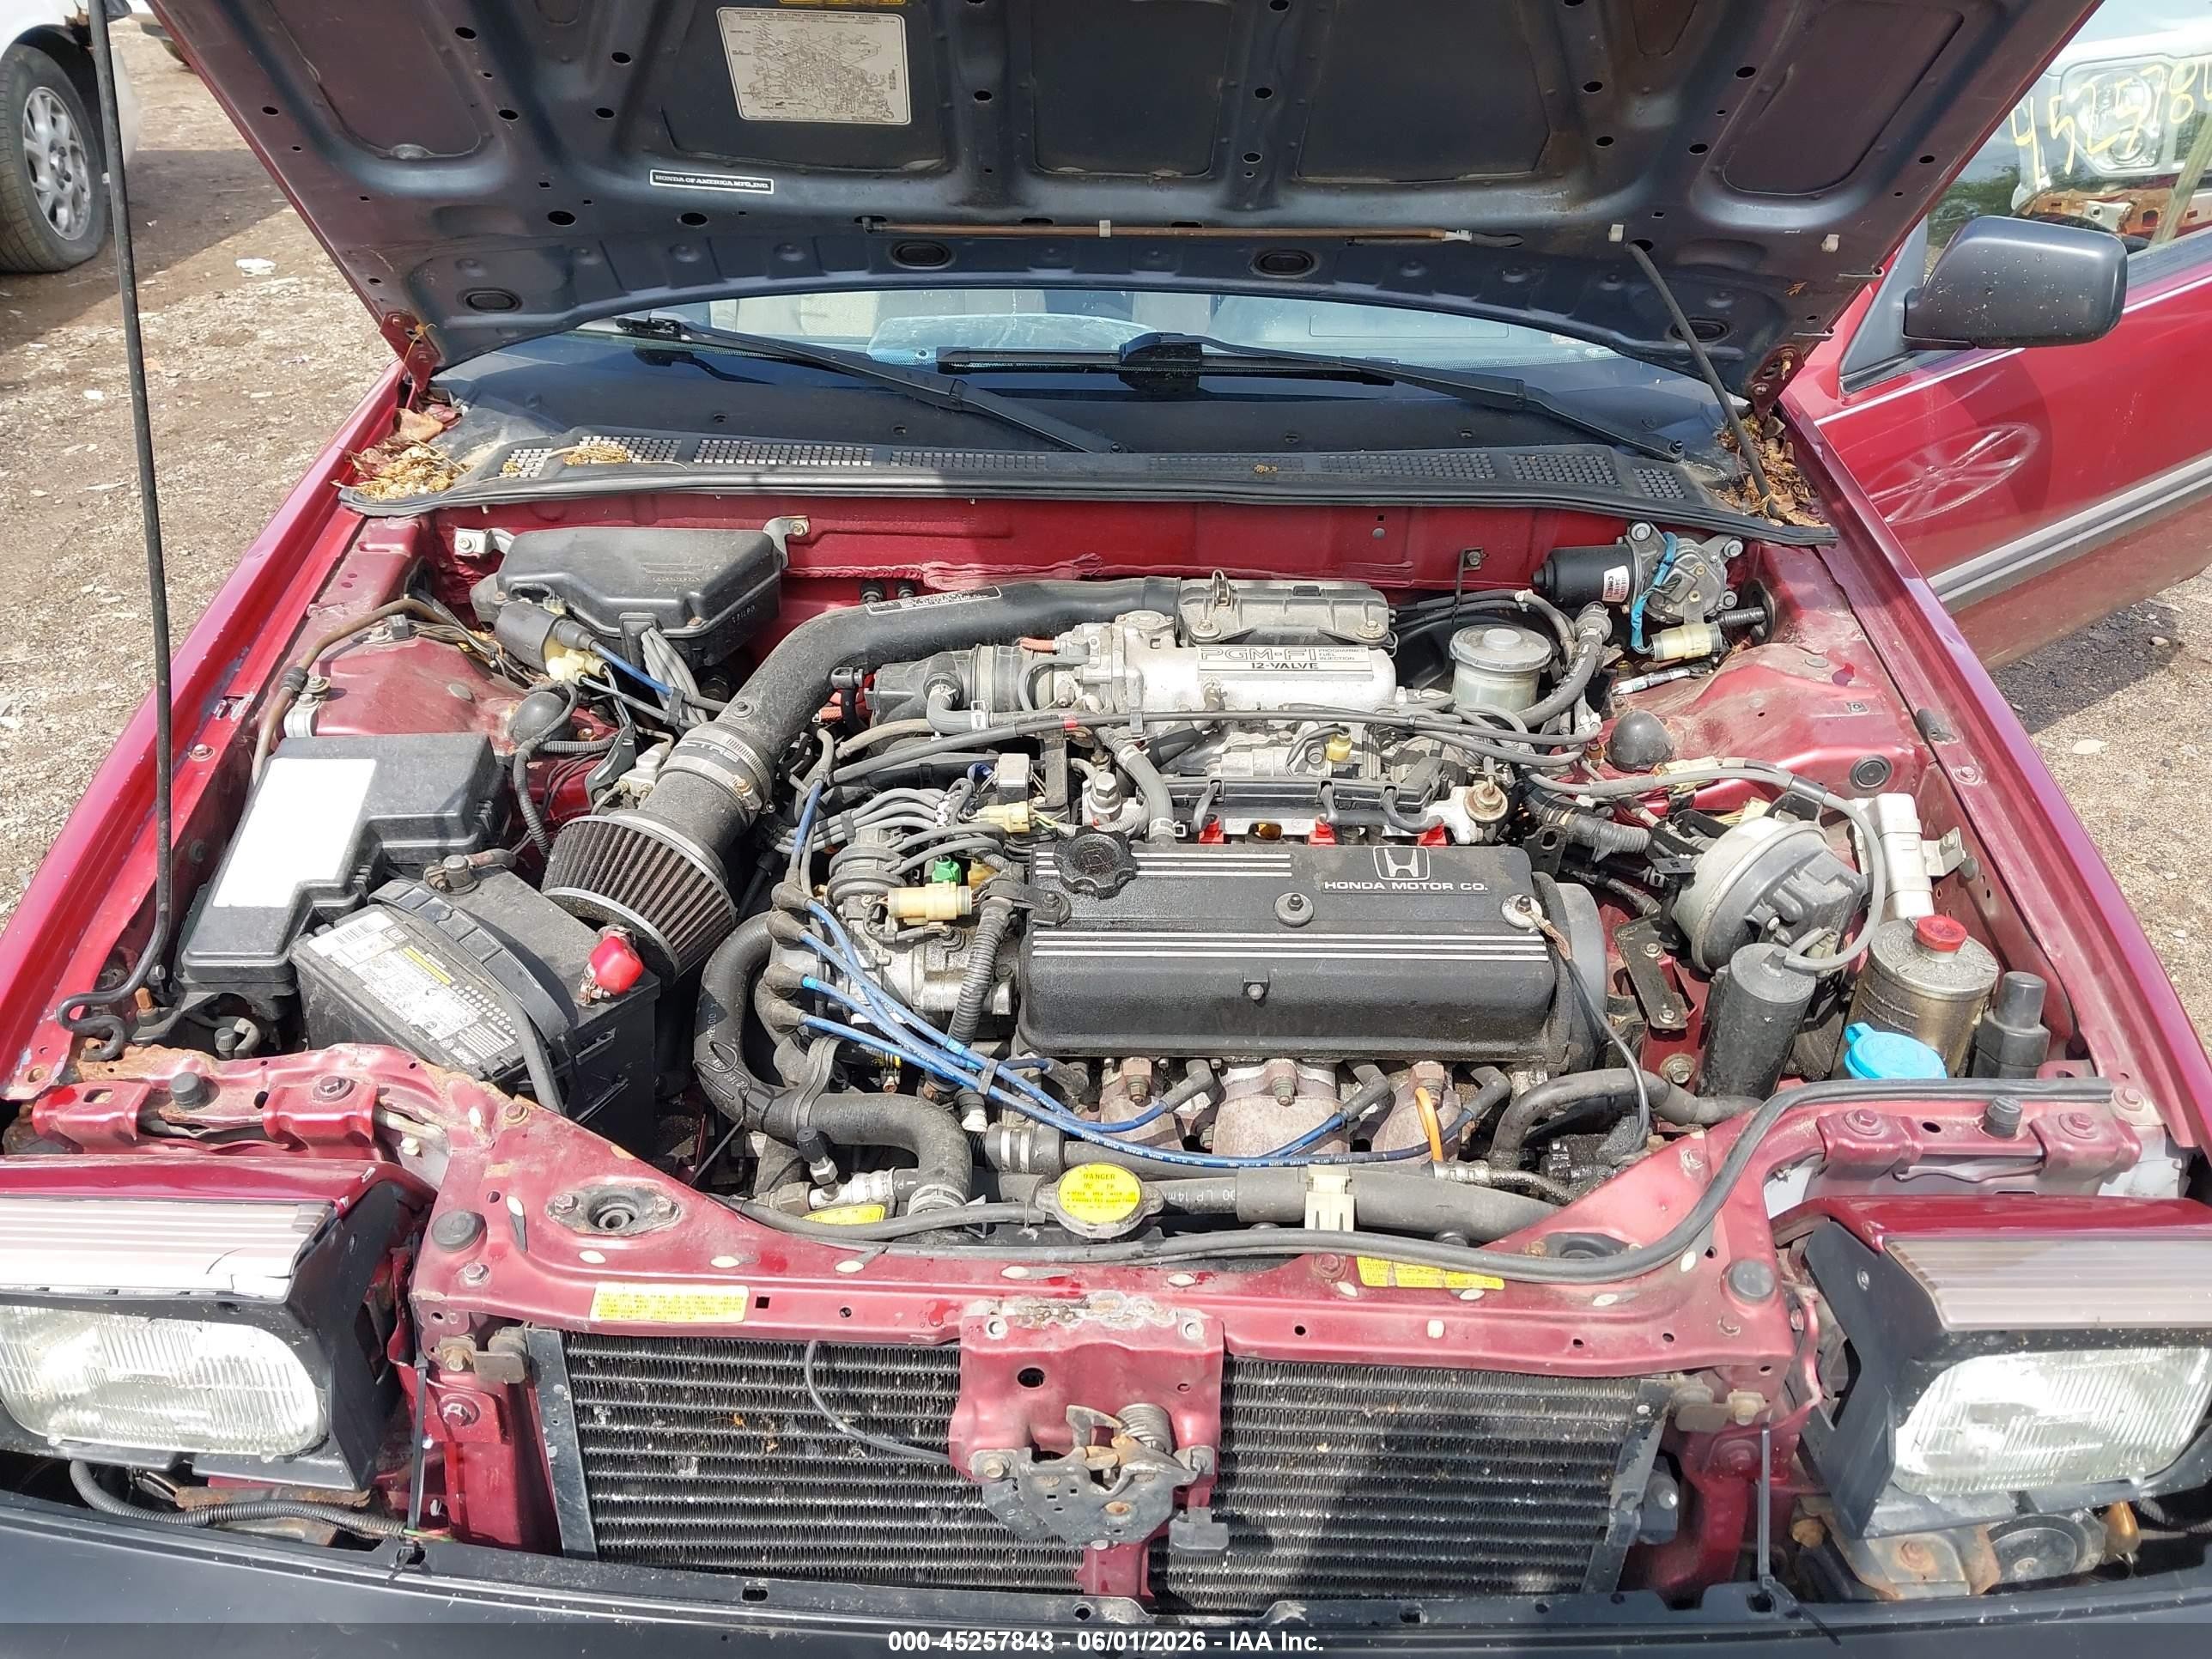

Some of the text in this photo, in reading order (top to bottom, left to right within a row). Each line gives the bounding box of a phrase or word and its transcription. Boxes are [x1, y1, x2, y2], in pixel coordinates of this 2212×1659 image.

[654, 174, 684, 183] HONDA
[696, 178, 732, 187] AMERICA
[1200, 647, 1316, 661] PGM-FI
[1324, 881, 1489, 891] HONDA MOTOR CO.
